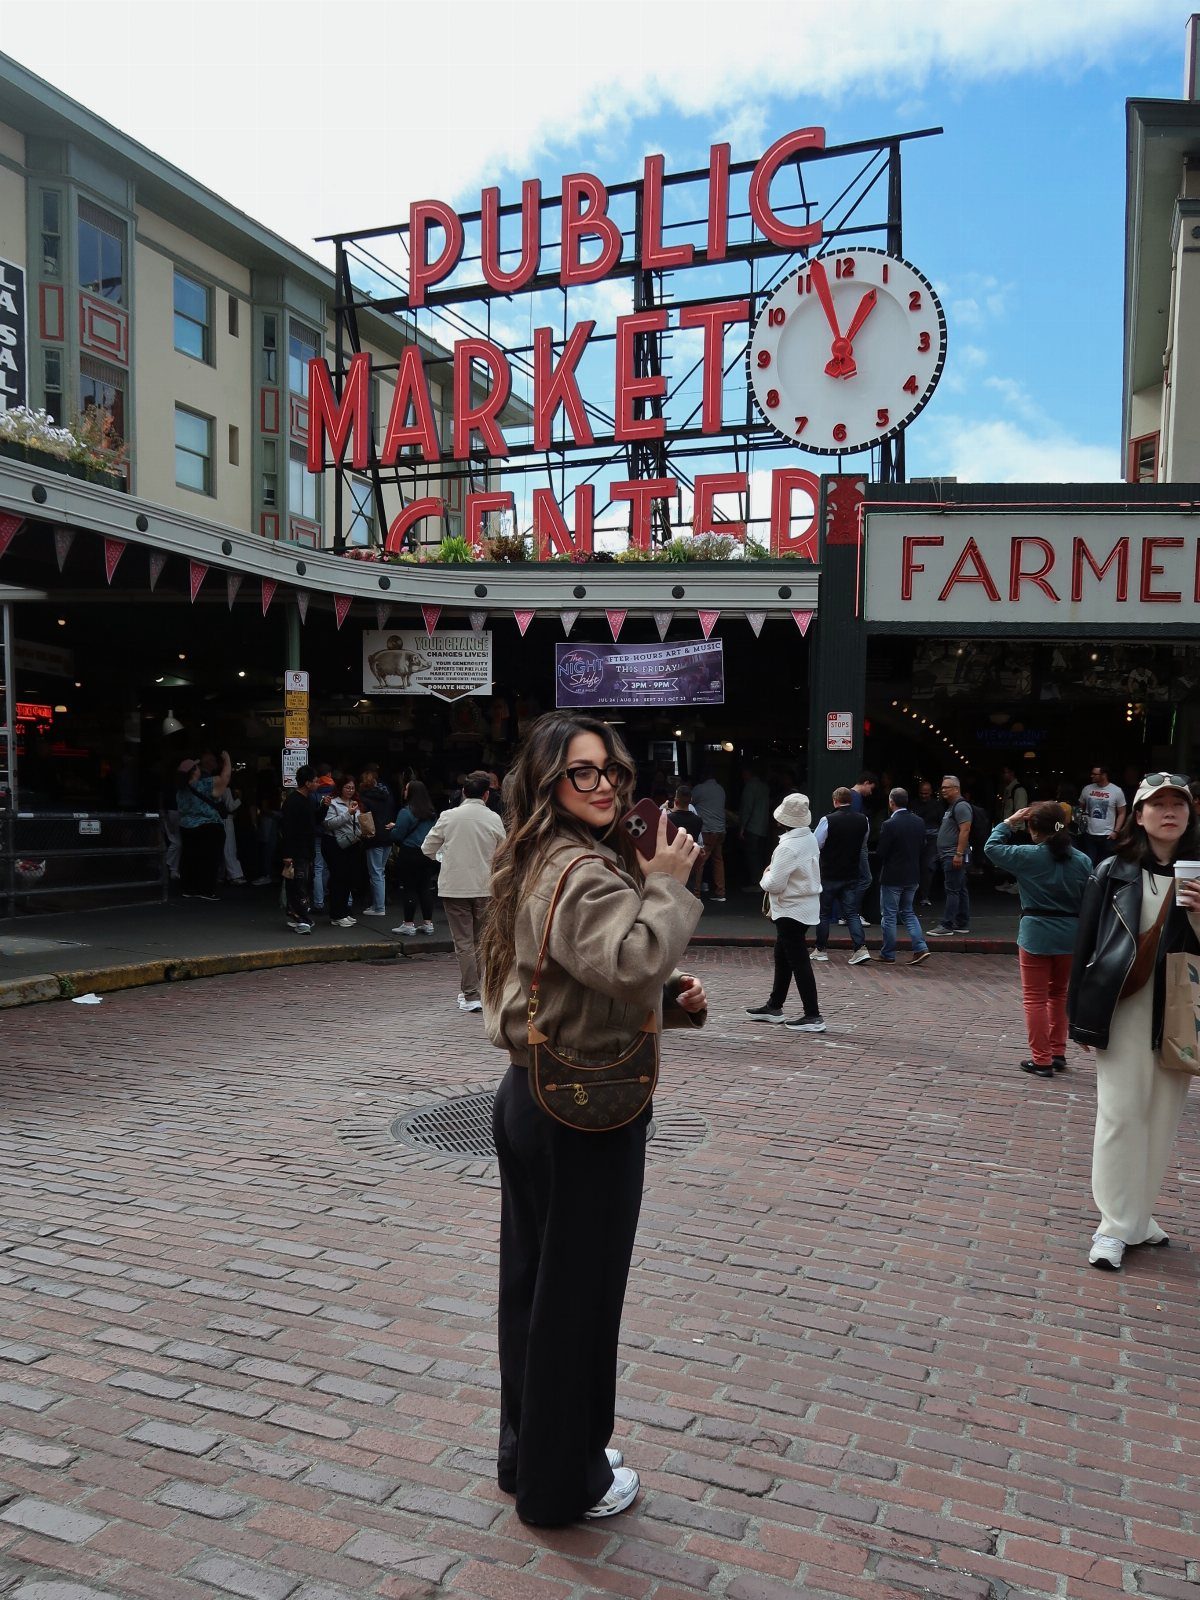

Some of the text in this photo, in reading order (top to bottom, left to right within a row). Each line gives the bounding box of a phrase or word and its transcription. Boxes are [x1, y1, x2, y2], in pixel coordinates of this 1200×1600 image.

[409, 127, 825, 306] PUBLIC
[836, 258, 855, 278] 12
[882, 264, 888, 284] 1
[797, 274, 811, 295] 11
[908, 291, 922, 311] 2
[768, 308, 785, 327] 10
[917, 332, 930, 352] 3
[757, 350, 771, 368] 9
[307, 300, 750, 473] MARKET
[903, 375, 918, 395] 4
[766, 389, 780, 408] 8
[795, 416, 808, 434] 7
[876, 408, 889, 427] 5
[833, 423, 847, 441] 6
[901, 536, 1200, 603] FARME
[414, 636, 489, 651] YOUR CHANGE
[693, 643, 721, 652] MUSIC
[566, 653, 583, 662] The
[558, 658, 603, 677] NIGHT
[569, 672, 601, 688] Shift
